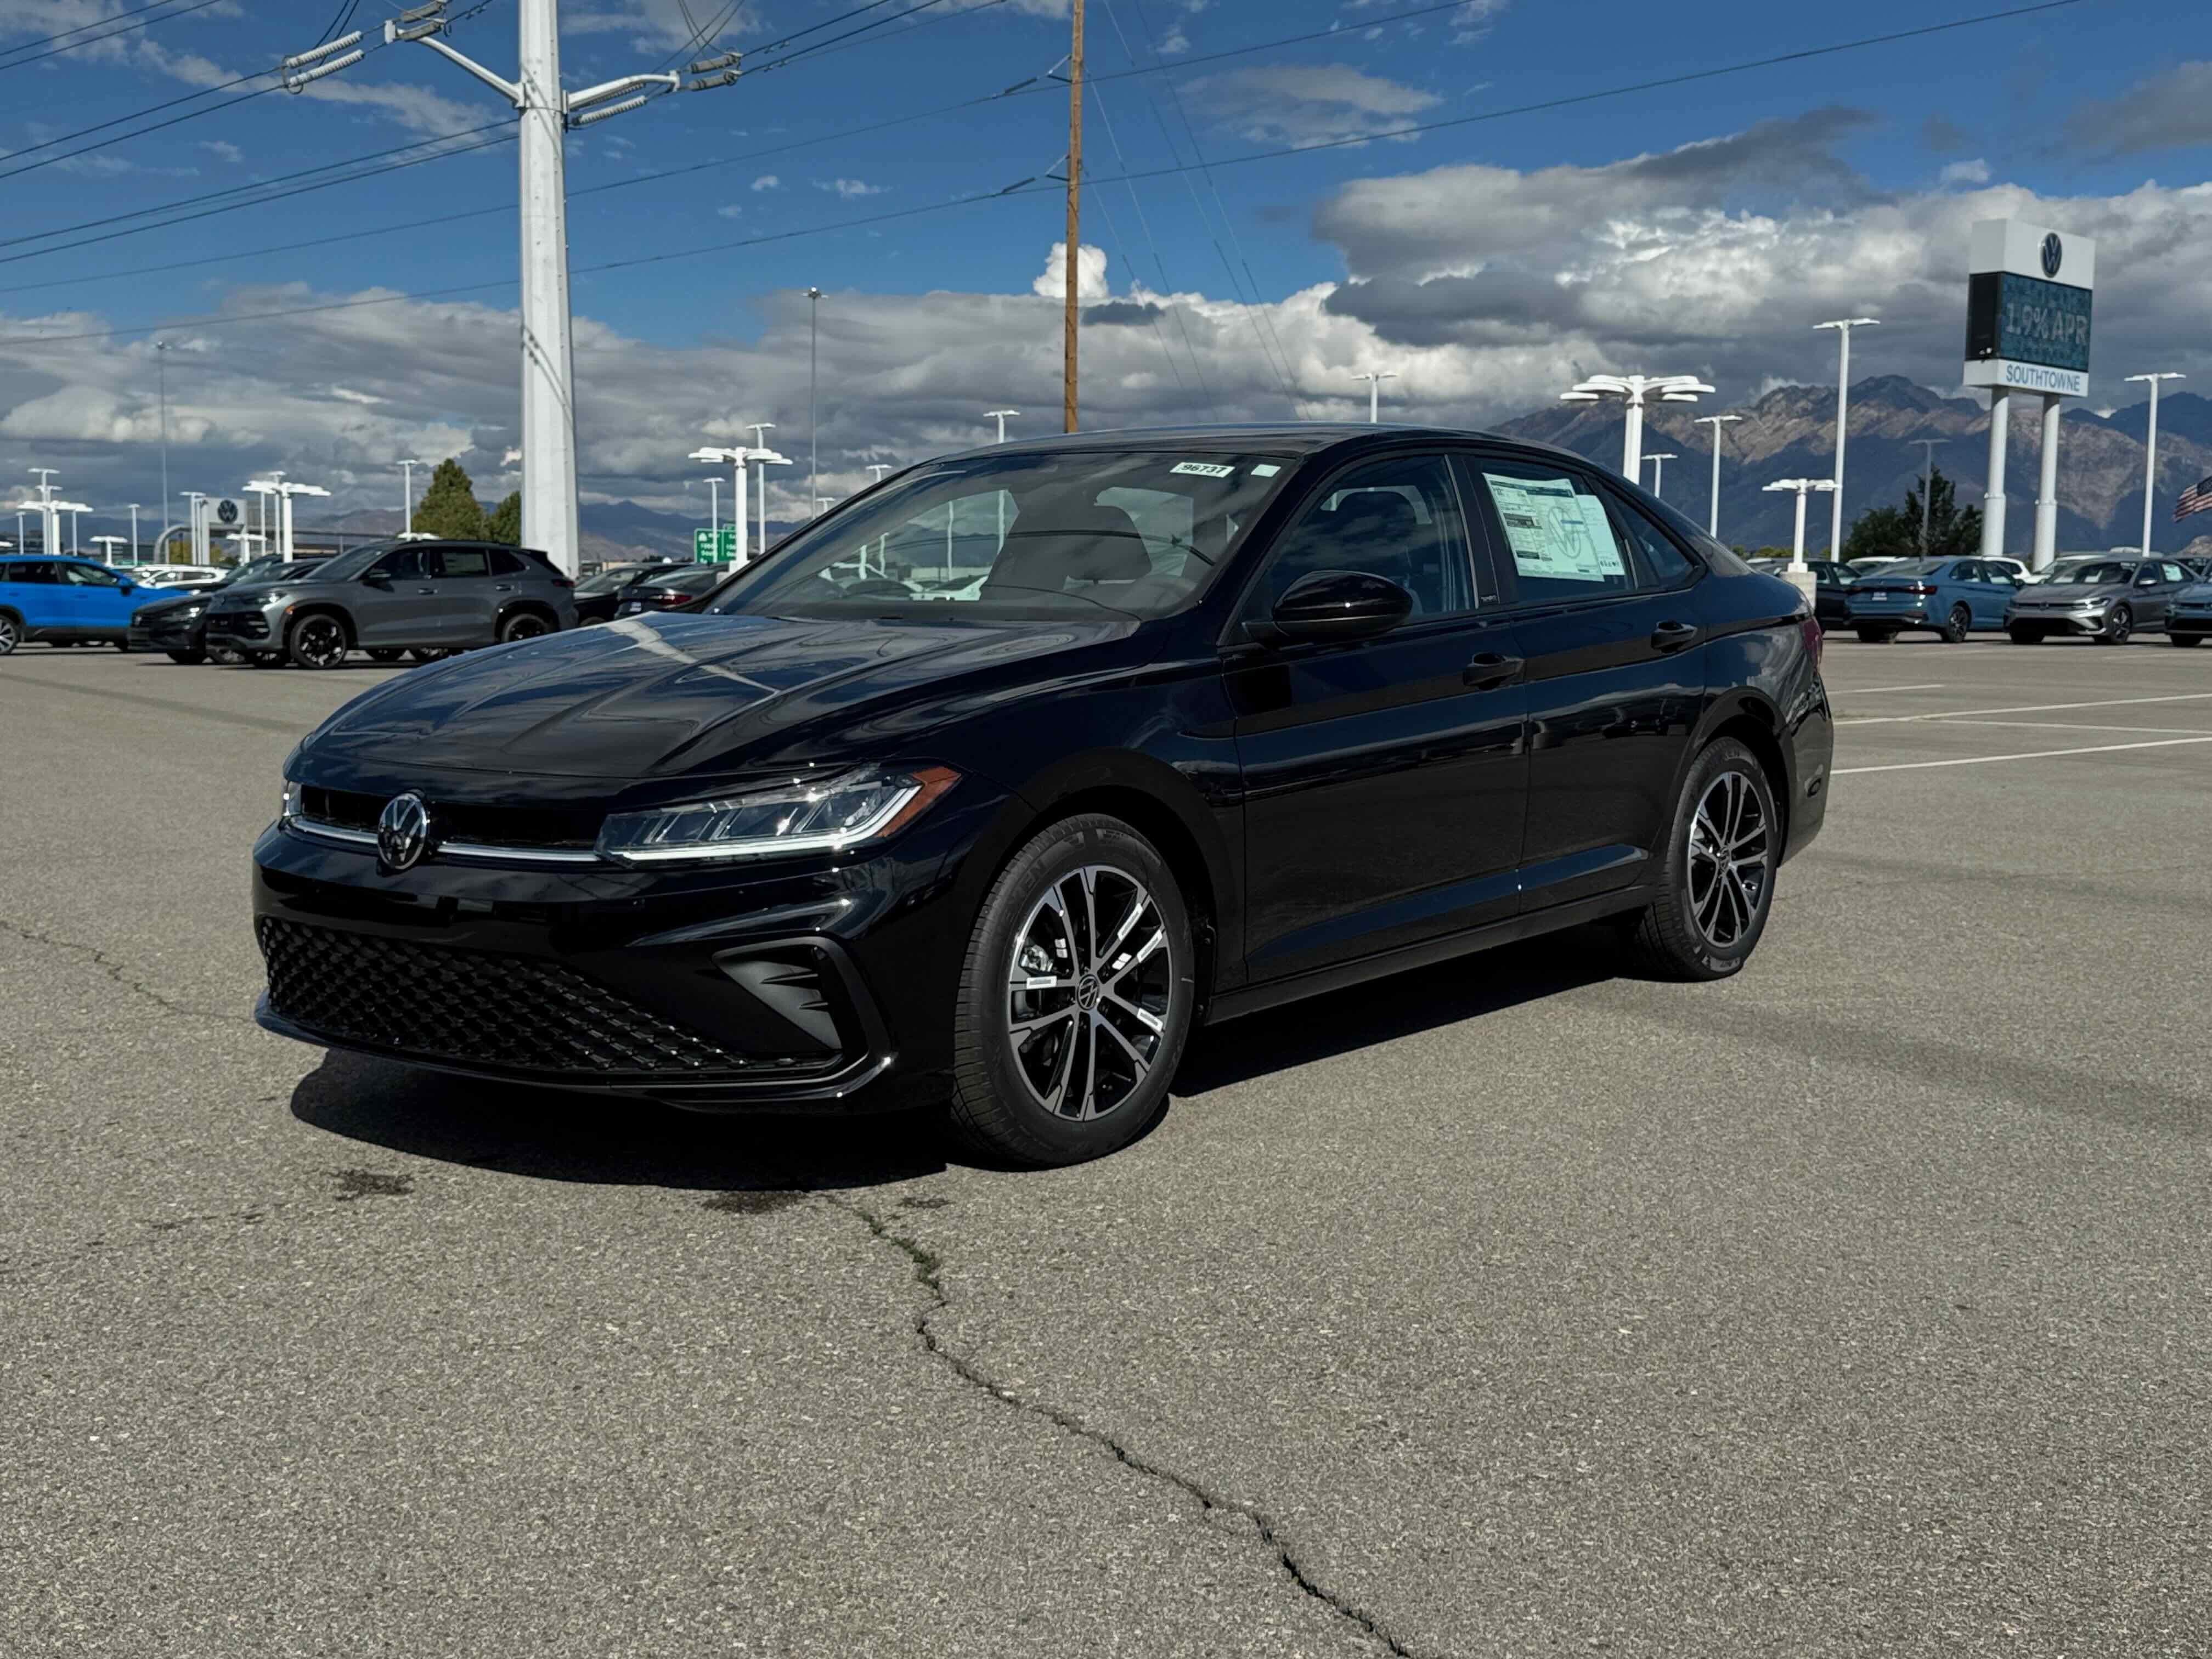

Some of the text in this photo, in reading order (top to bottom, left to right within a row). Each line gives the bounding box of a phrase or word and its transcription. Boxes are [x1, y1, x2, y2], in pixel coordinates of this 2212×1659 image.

[2051, 311, 2088, 346] APR
[2006, 364, 2081, 392] SOUTHTOWNE
[1181, 464, 1227, 473] 96737
